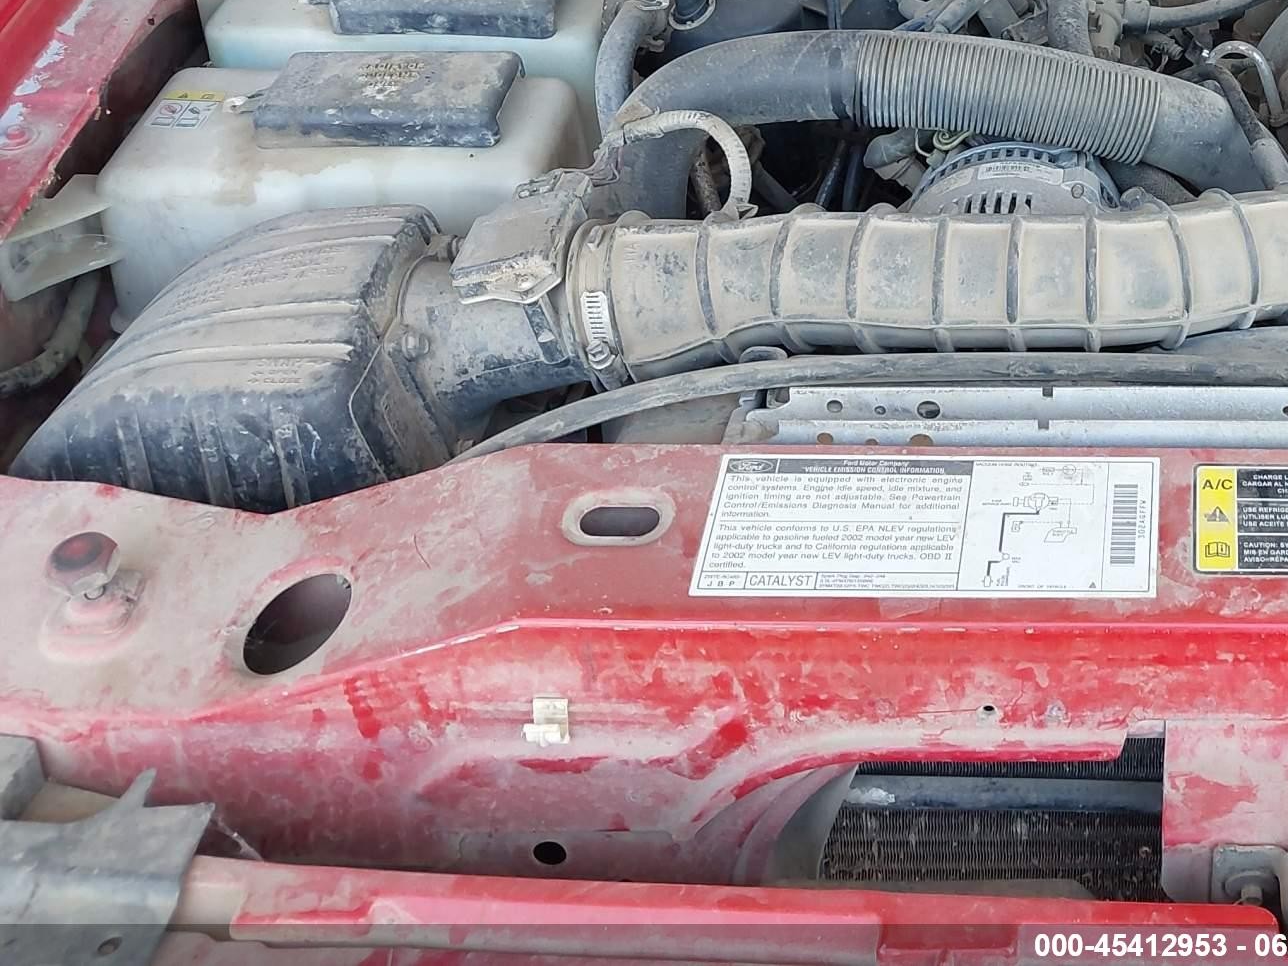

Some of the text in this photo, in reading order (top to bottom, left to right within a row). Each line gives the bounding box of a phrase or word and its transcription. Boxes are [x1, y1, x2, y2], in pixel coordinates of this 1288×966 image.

[730, 475, 750, 483] This
[755, 475, 788, 483] vehicle
[793, 475, 802, 483] is
[856, 476, 875, 484] with
[880, 476, 926, 484] electronic
[1202, 478, 1233, 490] A/C
[727, 484, 757, 492] control
[887, 485, 903, 493] idle
[815, 493, 830, 501] not
[888, 493, 907, 501] See
[911, 493, 961, 501] Powertrain
[811, 502, 856, 510] Diagnosis
[861, 502, 894, 510] Manual
[898, 502, 910, 510] for
[915, 502, 960, 510] additional
[719, 524, 737, 532] This
[740, 524, 772, 532] vehicle
[775, 524, 816, 532] conforms
[819, 524, 829, 532] to
[855, 524, 874, 532] EPA
[877, 525, 903, 533] NLEV
[907, 525, 957, 533] regulations
[714, 533, 956, 542] applicable to gasoline fueled 2002 model year new LEV
[756, 543, 782, 551] trucks
[785, 543, 801, 551] and
[803, 543, 812, 551] to
[814, 543, 856, 551] California
[859, 543, 906, 551] regulations
[711, 552, 719, 560] to
[722, 552, 744, 560] 2002
[747, 552, 775, 560] model
[778, 552, 797, 560] year
[800, 552, 818, 560] new
[821, 552, 840, 560] LEV
[843, 552, 884, 560] light-duty
[919, 552, 940, 561] OBD
[749, 574, 812, 586] CATALYST
